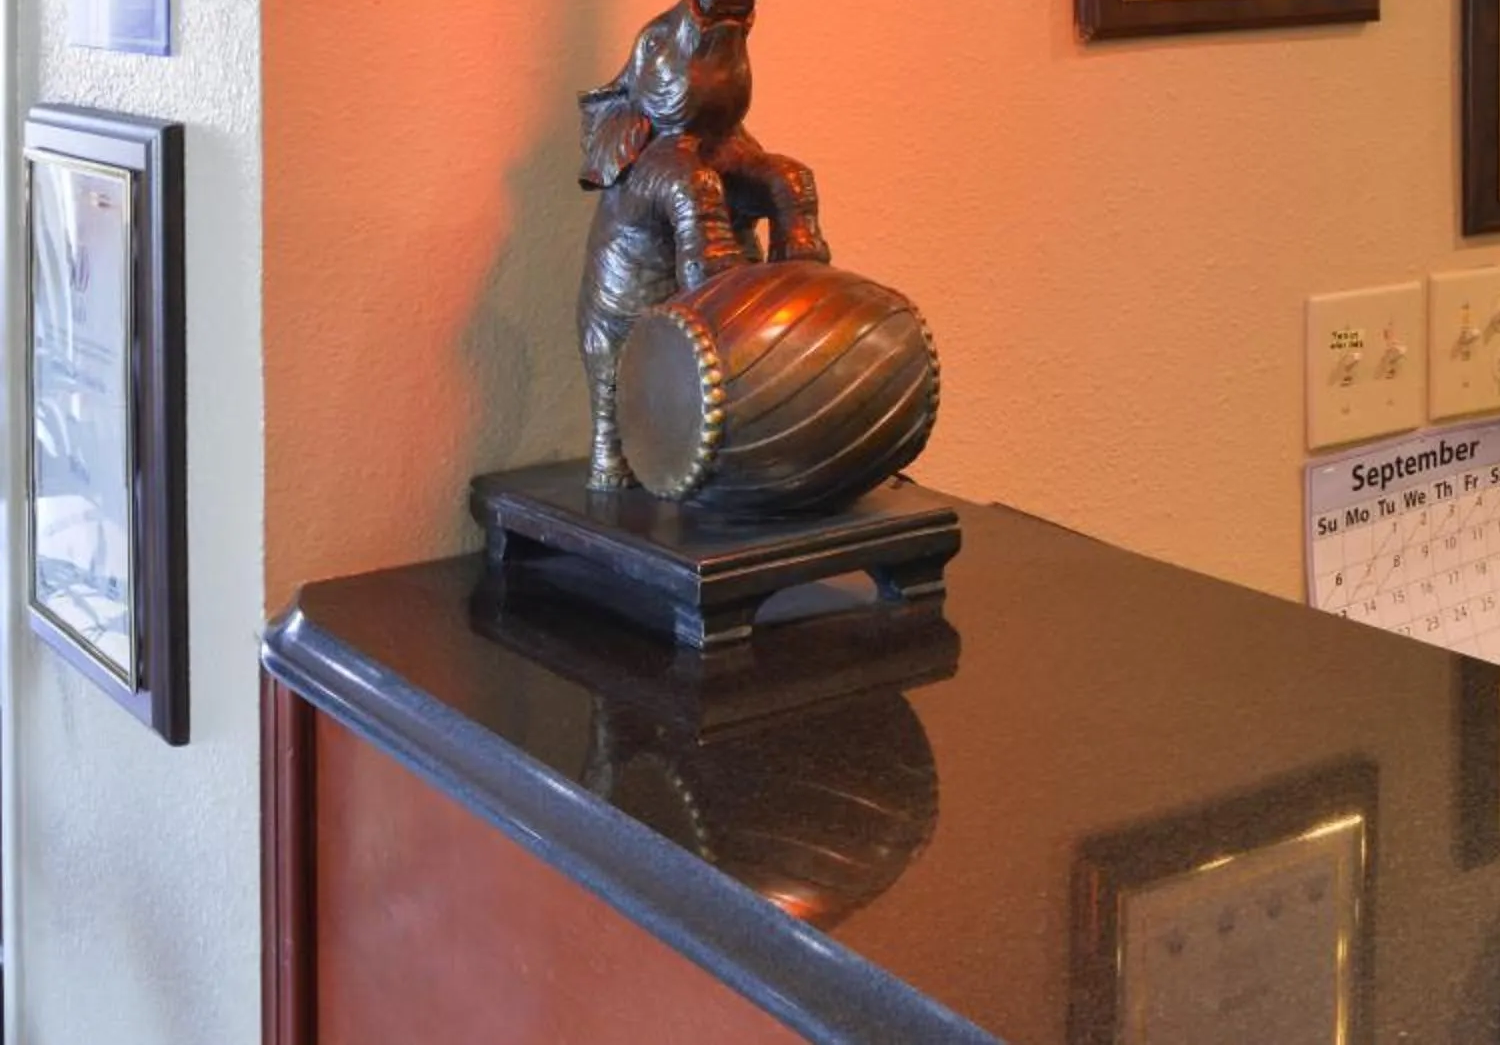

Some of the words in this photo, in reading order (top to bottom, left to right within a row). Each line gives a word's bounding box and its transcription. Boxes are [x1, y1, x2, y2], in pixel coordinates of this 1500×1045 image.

[1352, 439, 1480, 491] September
[1317, 516, 1338, 536] Su
[1345, 508, 1370, 528] Mo
[1377, 497, 1396, 517] Tu
[1403, 490, 1427, 510] We
[1435, 481, 1453, 500] Th
[1464, 474, 1479, 491] Fr
[1335, 573, 1343, 586] 6
